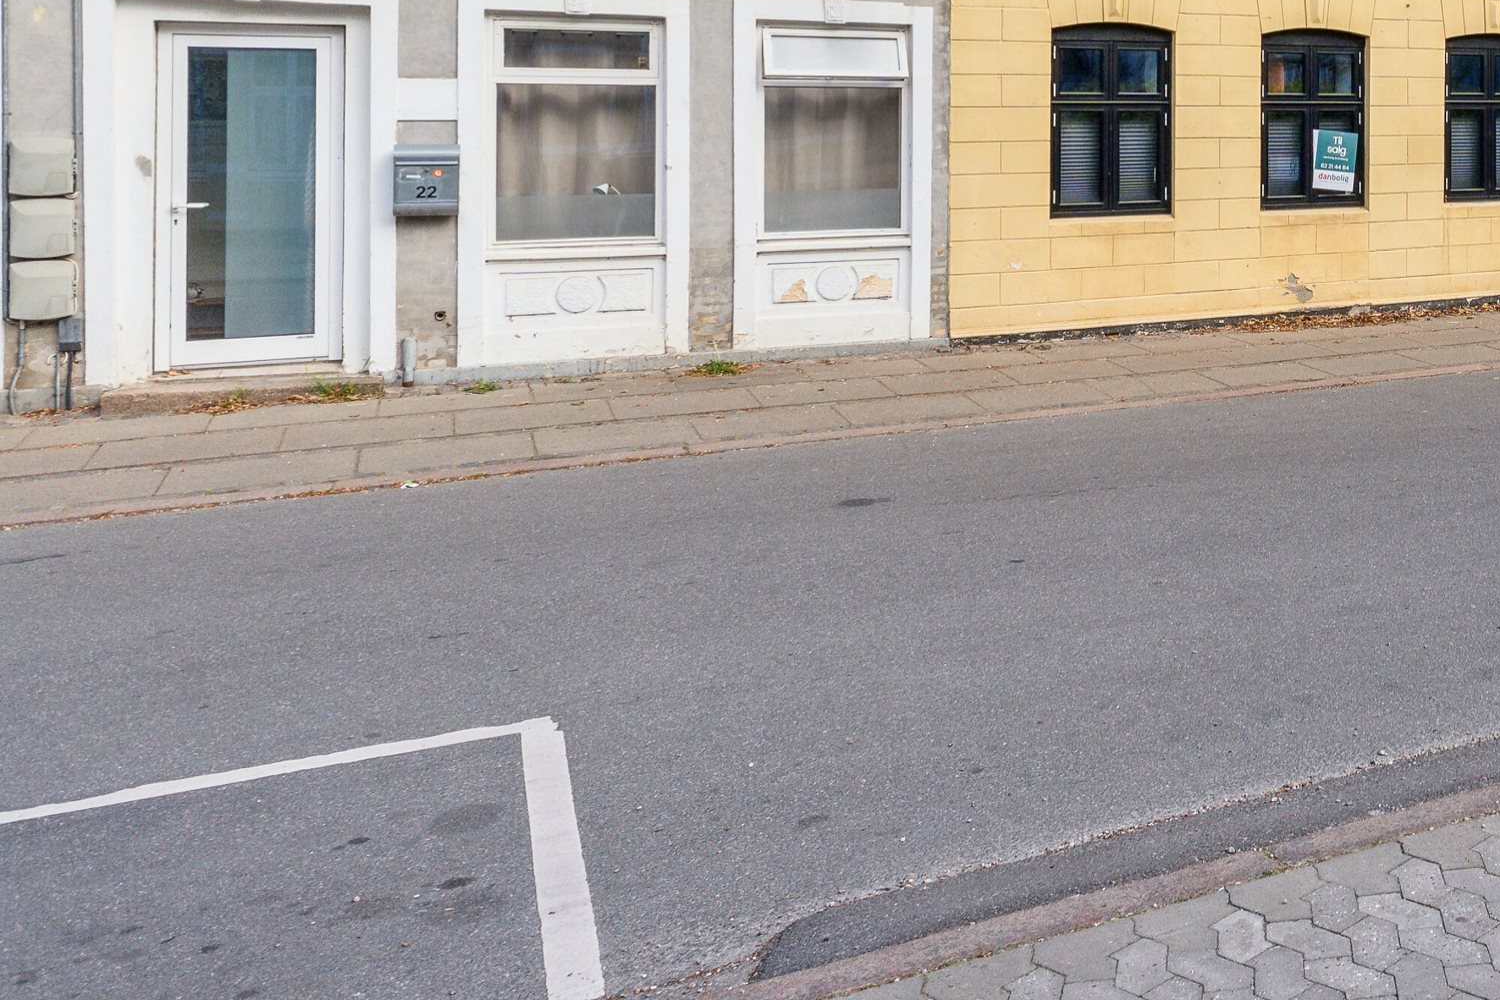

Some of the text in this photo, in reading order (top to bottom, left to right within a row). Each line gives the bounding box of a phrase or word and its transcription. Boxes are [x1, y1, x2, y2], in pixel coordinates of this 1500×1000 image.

[1334, 136, 1343, 145] Til
[1327, 145, 1347, 157] salg
[1318, 172, 1349, 183] danbolig
[416, 186, 437, 198] 22
